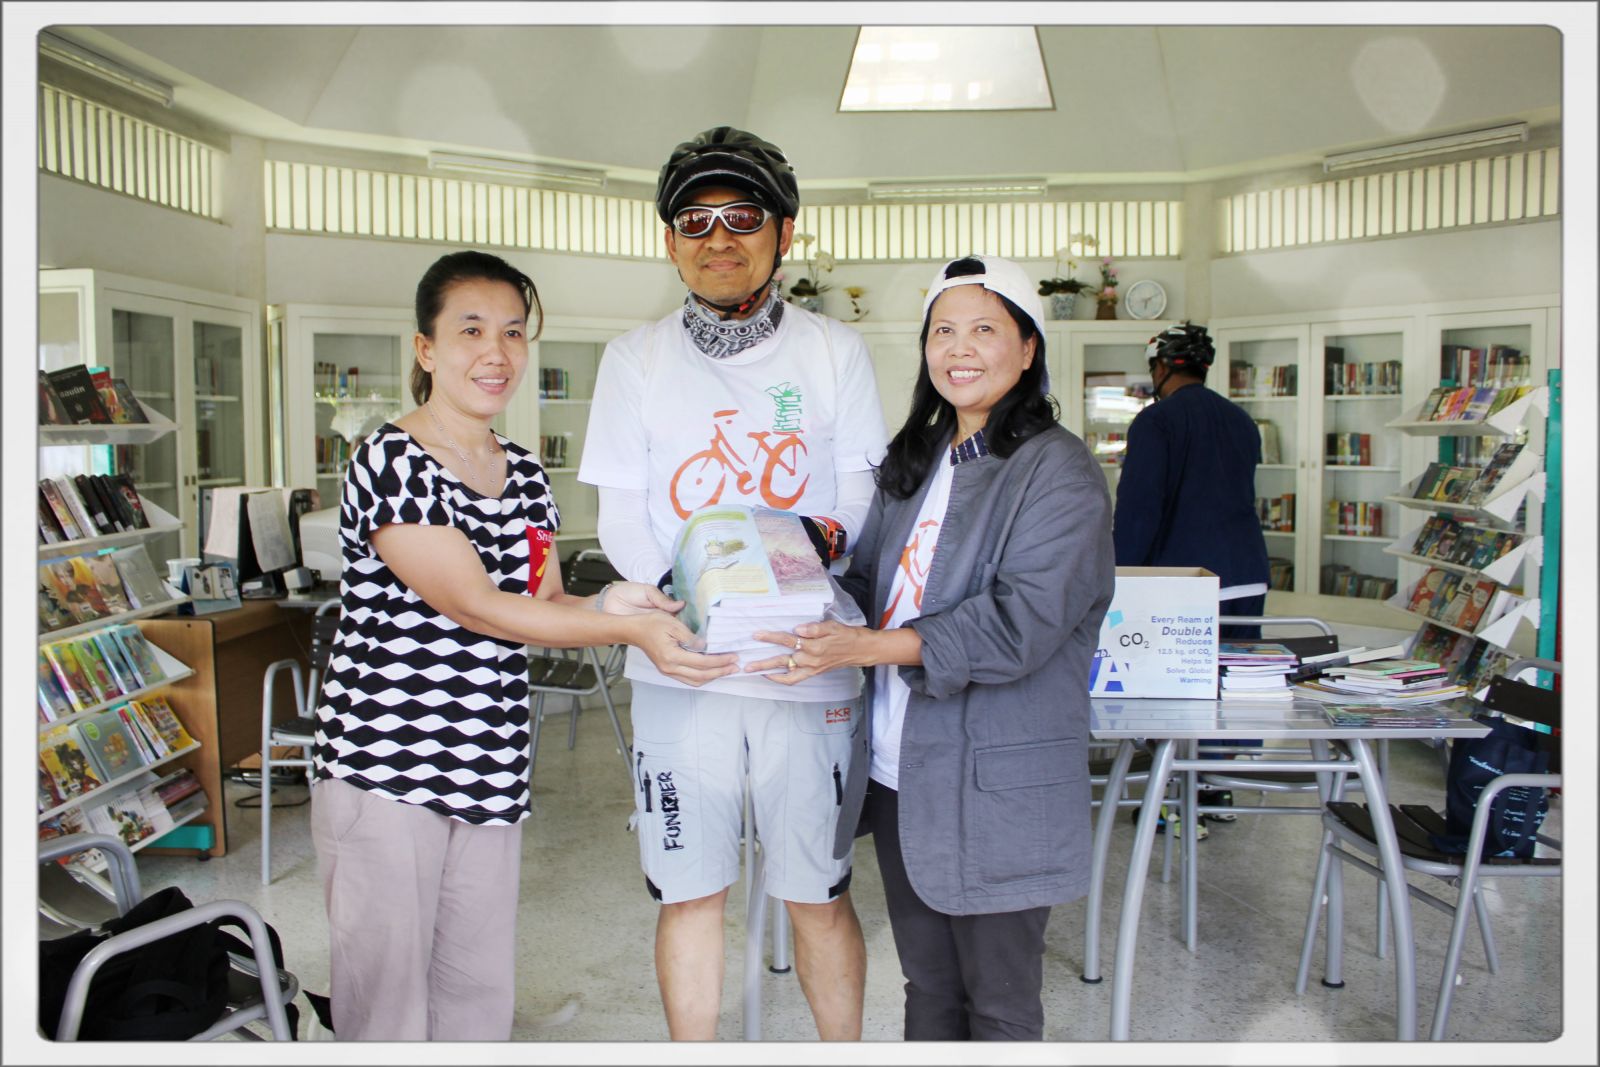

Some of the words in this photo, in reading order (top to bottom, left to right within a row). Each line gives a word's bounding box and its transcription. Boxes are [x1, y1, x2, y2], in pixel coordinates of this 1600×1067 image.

[1151, 616, 1175, 624] Every
[1162, 626, 1202, 636] Double
[1204, 626, 1213, 636] A
[1175, 637, 1213, 645] Reduces
